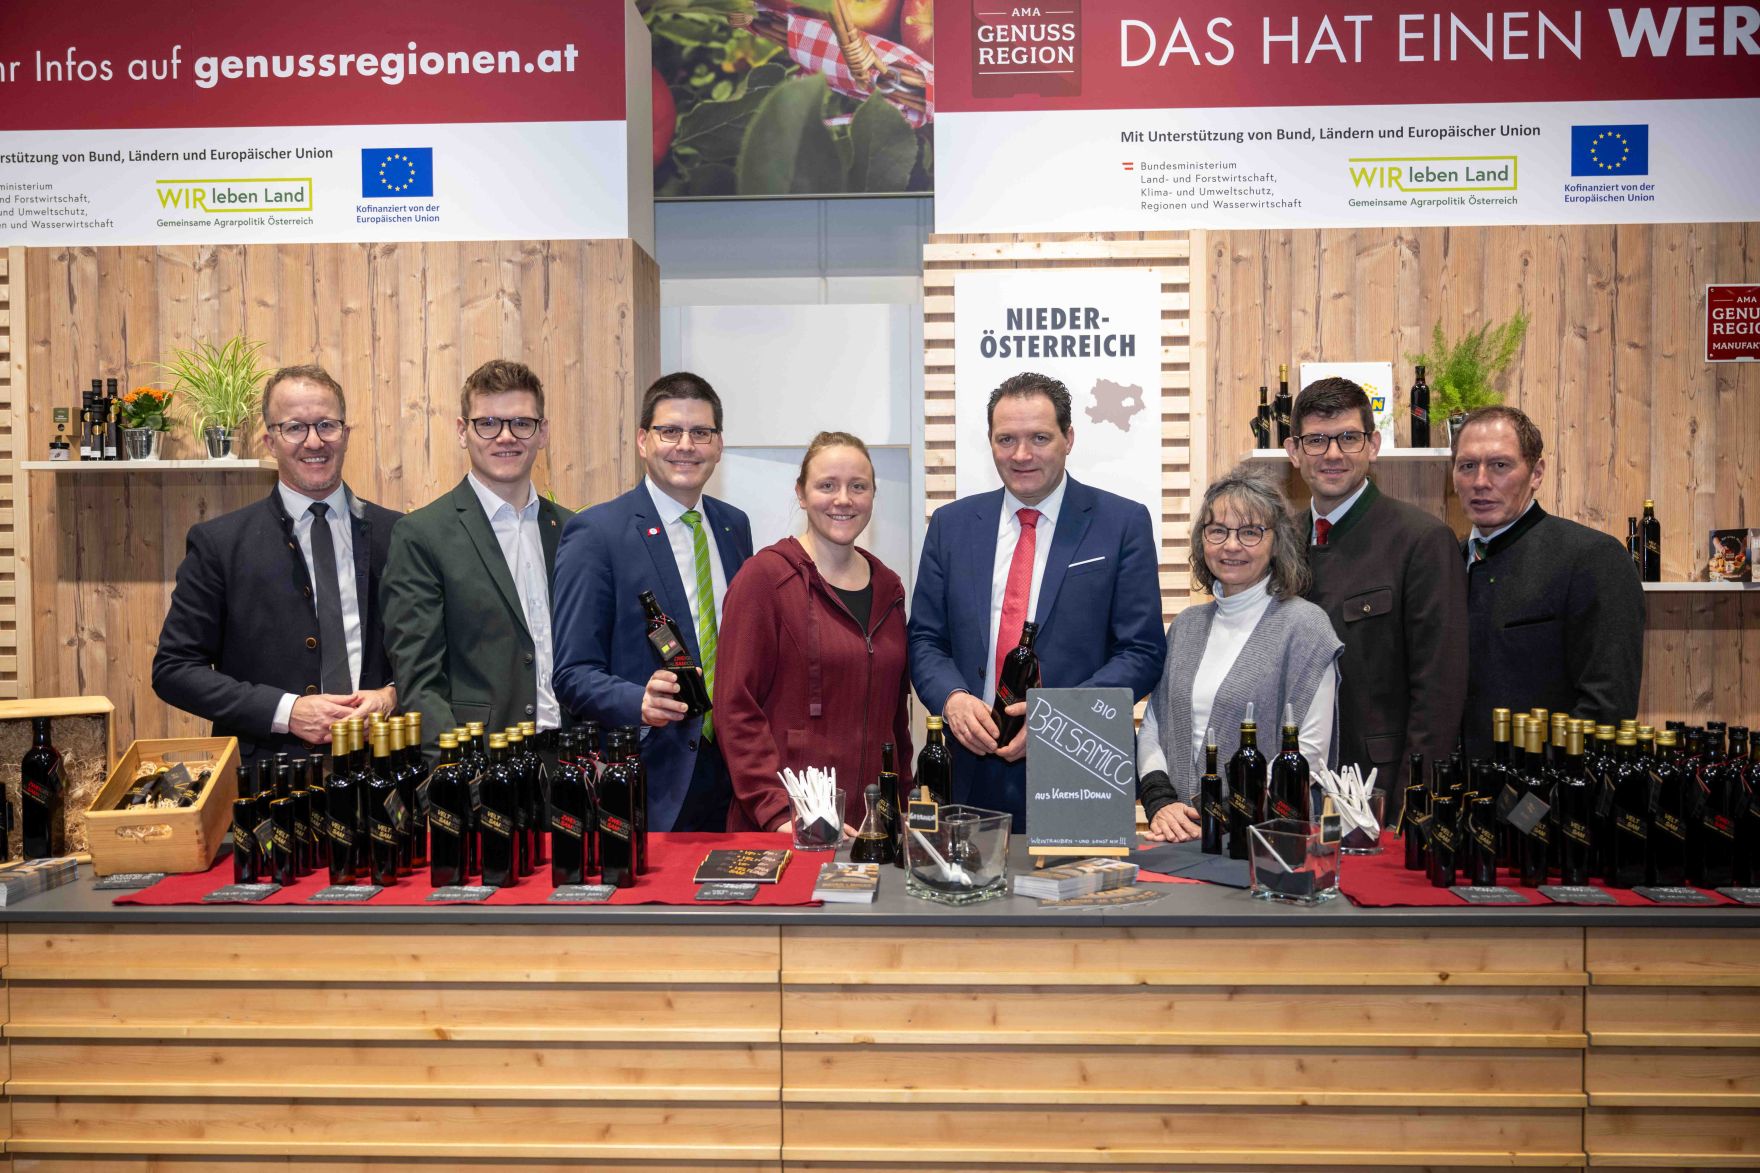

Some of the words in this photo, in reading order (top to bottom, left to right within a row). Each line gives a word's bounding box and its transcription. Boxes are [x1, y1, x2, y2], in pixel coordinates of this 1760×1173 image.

[1011, 7, 1041, 17] AMA
[977, 23, 1076, 43] GENUSS
[1120, 16, 1235, 68] DAS
[1263, 14, 1373, 65] HAT
[1398, 10, 1582, 62] EINEN
[1608, 5, 1760, 57] WER
[978, 45, 1075, 65] REGION
[36, 46, 113, 82] Infos
[127, 44, 182, 81] auf
[194, 41, 579, 89] genussregionen.at
[1121, 130, 1144, 143] Mit
[1148, 129, 1244, 144] Unterstützung
[1247, 131, 1273, 141] von
[1276, 127, 1316, 142] Bund,
[1319, 126, 1374, 140] Ländern
[1378, 126, 1404, 139] und
[1408, 124, 1497, 141] Europäischer
[1500, 124, 1541, 137] Union
[61, 153, 85, 163] von
[88, 150, 125, 164] Bund,
[128, 149, 179, 162] Ländern
[183, 148, 207, 161] und
[210, 147, 292, 163] Europäischer
[295, 147, 333, 159] Union
[1140, 161, 1237, 171] Bundesministerium
[1141, 174, 1169, 184] Land-
[1173, 174, 1191, 184] und
[1195, 173, 1277, 184] Forstwirtschaft,
[1349, 166, 1403, 189] WIR
[1409, 165, 1459, 183] leben
[1465, 164, 1509, 182] Land
[1141, 187, 1172, 197] Klima-
[1176, 187, 1195, 197] und
[1199, 187, 1274, 198] Umweltschutz,
[1564, 183, 1619, 192] Kofinanziert
[1620, 184, 1638, 193] von
[1639, 182, 1656, 192] der
[14, 193, 91, 205] Forstwirtschaft,
[156, 187, 207, 209] WIR
[212, 187, 258, 204] leben
[264, 186, 304, 203] Land
[1348, 198, 1408, 207] Gemeinsame
[1410, 196, 1466, 209] Agrarpolitik
[1468, 194, 1518, 206] Österreich
[1564, 193, 1625, 204] Europäischen
[1627, 193, 1655, 203] Union
[18, 206, 88, 218] Umweltschutz,
[356, 204, 407, 213] Kofinanziert
[425, 204, 440, 212] der
[1141, 201, 1187, 213] Regionen
[1190, 200, 1209, 209] und
[1212, 198, 1302, 210] Wasserwirtschaft
[10, 221, 28, 230] und
[30, 218, 114, 229] Wasserwirtschaft
[156, 218, 212, 227] Gemeinsame
[213, 217, 265, 229] Agrarpolitik
[267, 215, 314, 226] Österreich
[356, 214, 413, 224] Europäischen
[414, 214, 440, 223] Union
[1006, 306, 1110, 331] NIEDER-
[979, 329, 1136, 359] ÖSTERREICH
[1712, 341, 1760, 350] MANUFAK
[1372, 398, 1384, 411] N
[1090, 698, 1117, 720] BIO
